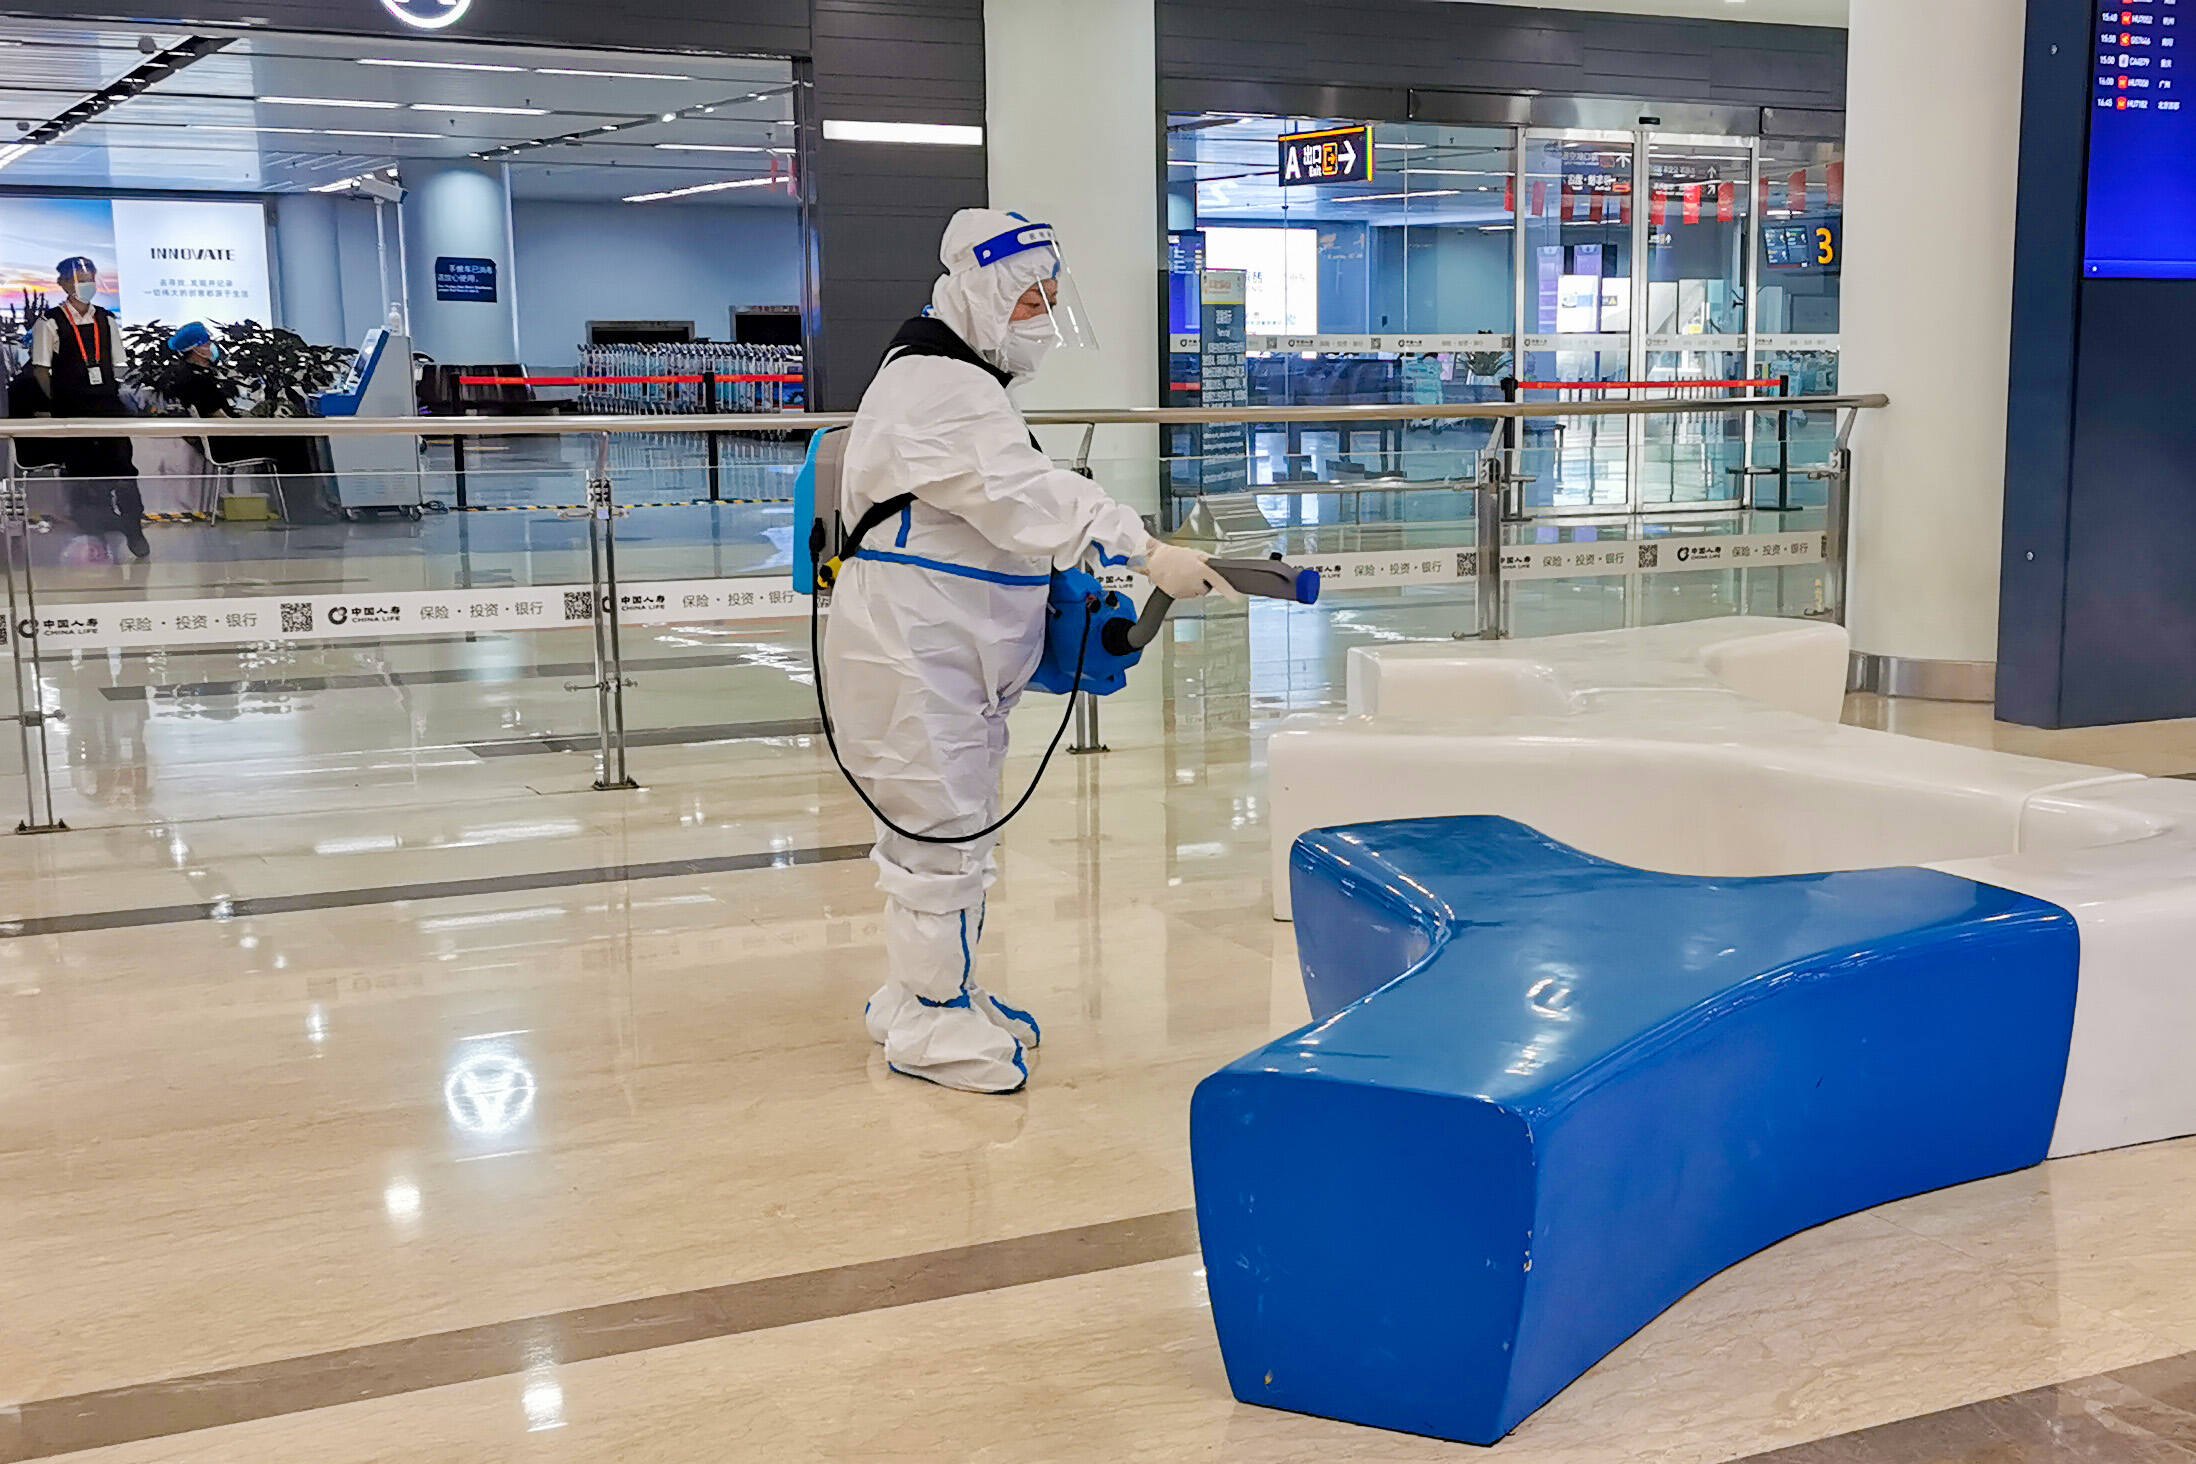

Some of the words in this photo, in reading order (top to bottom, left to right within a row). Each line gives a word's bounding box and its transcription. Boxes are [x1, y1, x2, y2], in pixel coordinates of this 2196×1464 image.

[1303, 145, 1322, 165] 出口
[1285, 146, 1301, 180] A
[1815, 227, 1834, 264] 3
[151, 247, 235, 261] INNOVATE
[621, 595, 665, 605] 中国人寿
[351, 606, 400, 617] 中国人寿
[43, 618, 98, 629] 中国人寿
